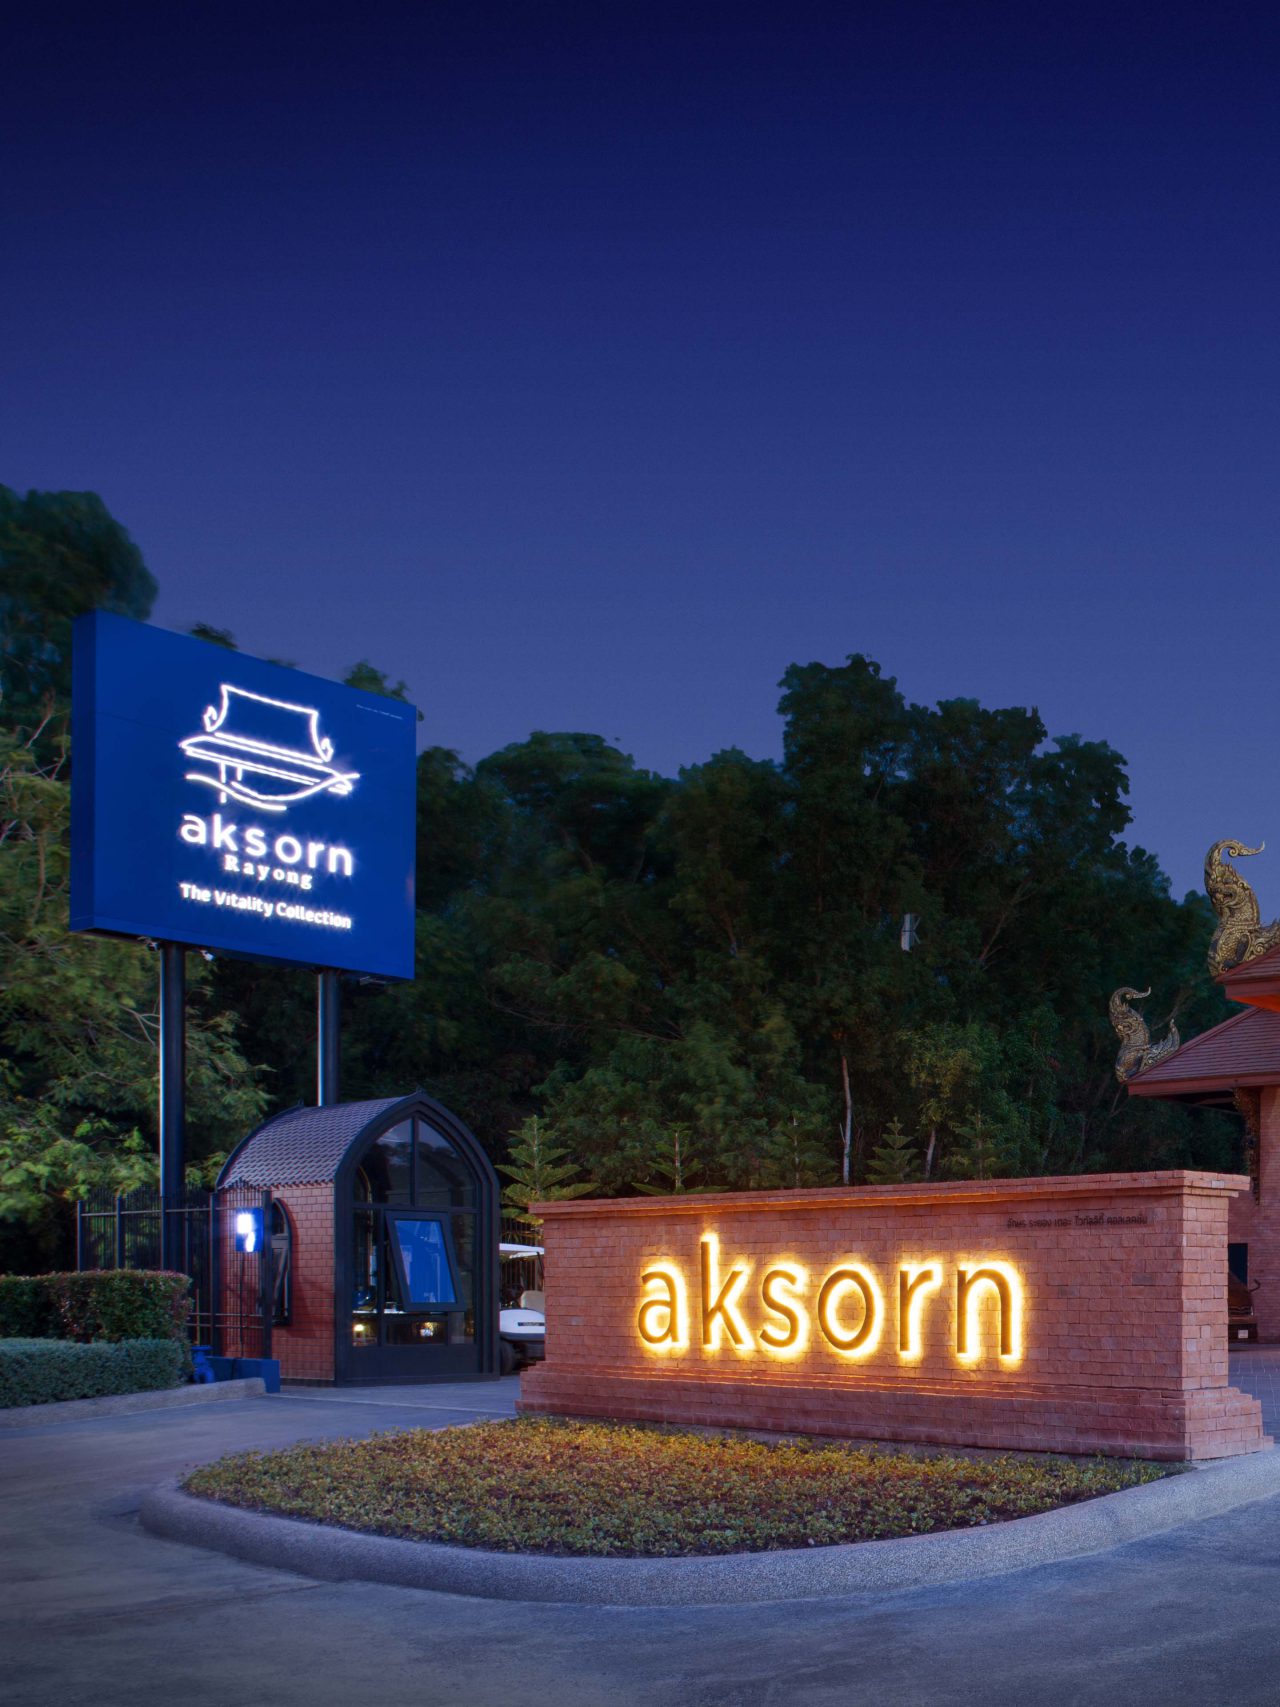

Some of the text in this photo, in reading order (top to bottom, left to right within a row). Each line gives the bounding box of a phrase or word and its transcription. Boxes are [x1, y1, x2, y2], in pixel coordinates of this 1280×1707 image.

[180, 814, 353, 876] aksorn
[224, 855, 313, 890] Rayong
[180, 883, 352, 929] The Vitality Collection
[637, 1234, 1024, 1362] aksorn
